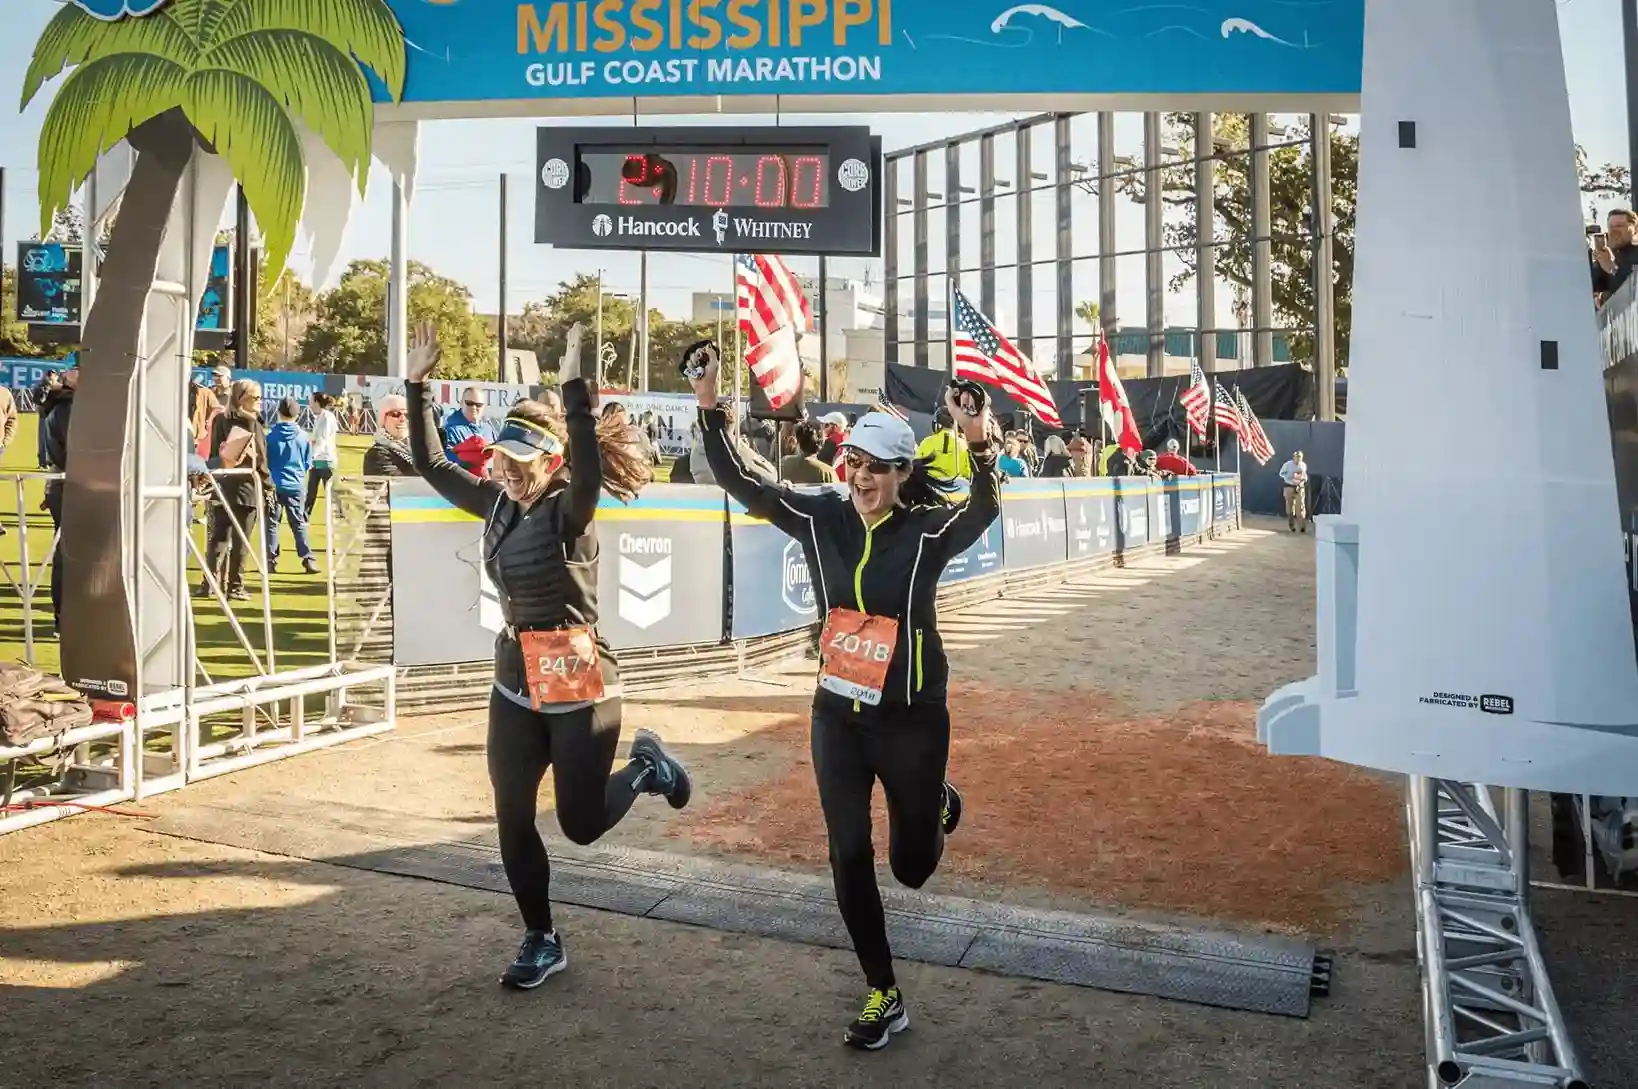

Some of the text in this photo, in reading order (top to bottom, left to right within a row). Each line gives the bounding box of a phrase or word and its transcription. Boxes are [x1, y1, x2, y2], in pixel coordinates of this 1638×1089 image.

[516, 0, 892, 54] MISSISSIPPI
[526, 55, 881, 86] GULF COAST MARATHON
[618, 216, 813, 239] Hancock WHITNEY
[619, 532, 672, 554] Chevron
[830, 631, 890, 662] 2018
[1419, 697, 1467, 707] FABRICATED
[1433, 692, 1471, 701] DESIGNED
[1483, 697, 1511, 708] REBEL
